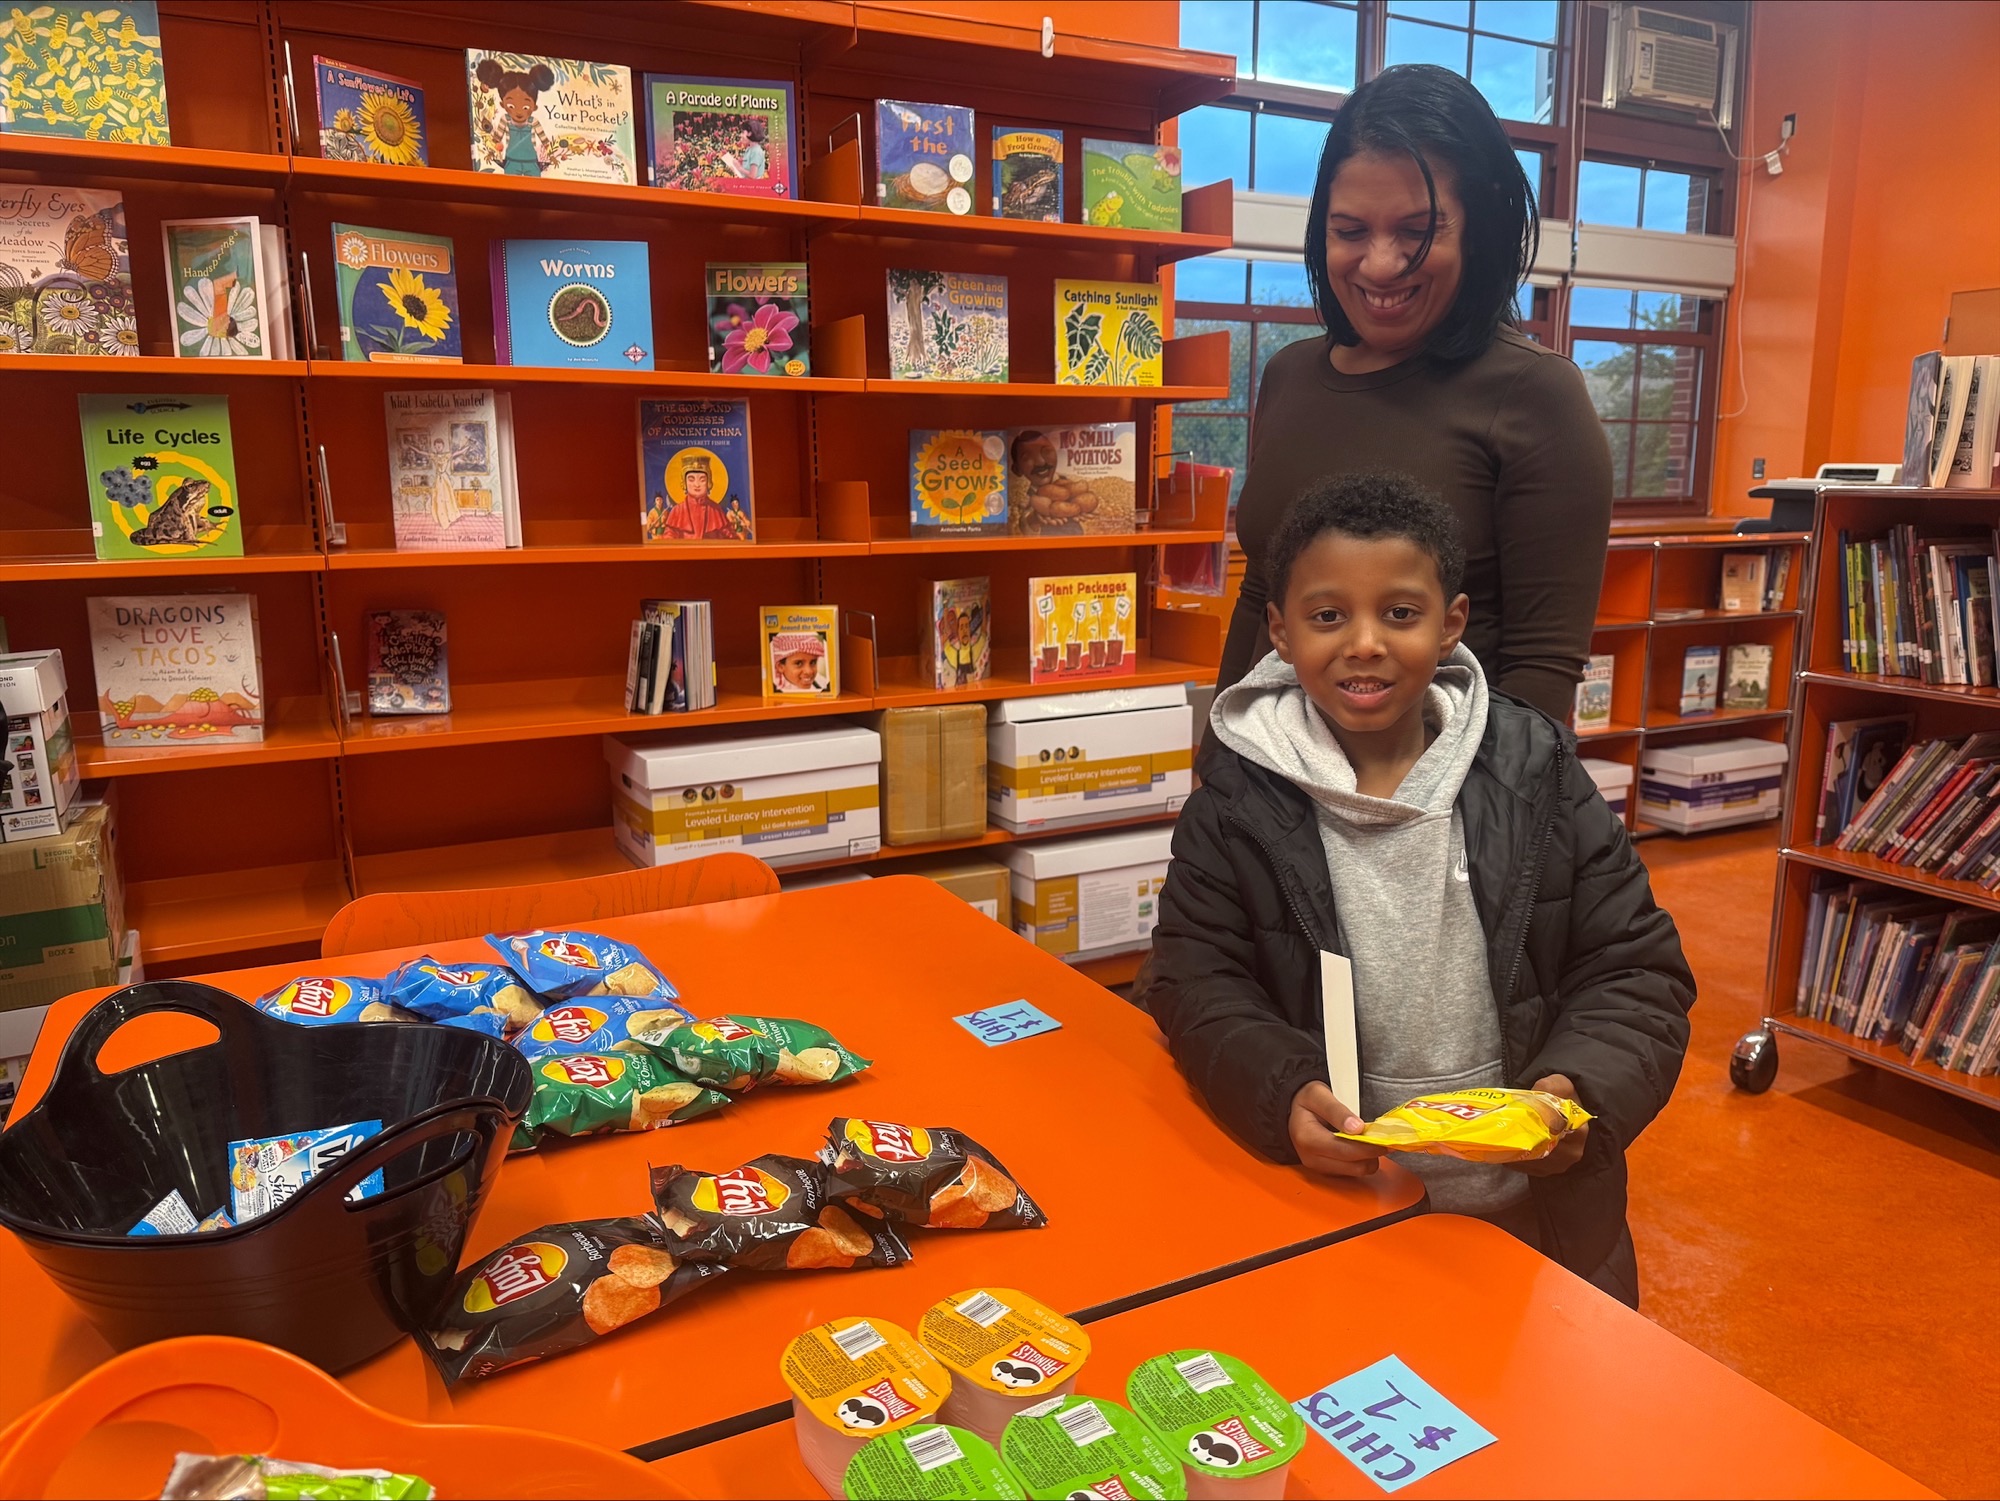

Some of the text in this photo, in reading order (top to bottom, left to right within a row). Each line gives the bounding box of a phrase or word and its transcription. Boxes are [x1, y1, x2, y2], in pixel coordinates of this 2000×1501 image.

[327, 70, 414, 102] A Sunflower's Life
[557, 90, 602, 109] What's
[666, 91, 778, 109] A Parade of Plants
[544, 105, 628, 126] Your Pocket?
[910, 136, 948, 155] the
[1015, 135, 1032, 143] How
[1092, 166, 1178, 214] The Trouble with Tadpoles
[48, 193, 85, 219] Eyes
[184, 229, 238, 277] Handsprings
[372, 243, 438, 267] Flowers
[540, 259, 615, 279] Worms
[715, 270, 798, 292] Flowers
[948, 277, 1003, 292] Green and
[949, 290, 1003, 308] Growing
[1065, 290, 1157, 306] Catching Sunlight
[390, 393, 484, 409] What Isabella Wanted
[655, 404, 731, 413] THE GODS AND
[664, 416, 724, 425] GODDESSES
[107, 429, 220, 447] Life Cycles
[648, 428, 742, 436] OF ANCIENT CHINA
[1060, 431, 1115, 448] NO SMALL
[955, 446, 964, 457] A
[1067, 449, 1121, 466] POTATOES
[937, 454, 982, 470] Seed
[922, 469, 998, 491] Grows
[1044, 582, 1127, 596] Plant Packages
[116, 605, 225, 625] DRAGONS
[141, 627, 204, 644] LOVE
[131, 646, 217, 666] TACOS
[1040, 765, 1142, 784] Leveled Literacy Intervention
[22, 818, 52, 826] LITERACY
[686, 804, 815, 827] Leveled Literacy Intervention
[784, 829, 811, 837] Materials
[33, 848, 46, 869] L
[44, 849, 72, 857] SECOND
[48, 949, 66, 957] BOX
[605, 941, 625, 970] Vinegar
[293, 978, 335, 1014] Lay's
[546, 1008, 591, 1040] Lay's
[768, 1021, 784, 1045] Onion
[964, 1011, 1017, 1042] CHIPS
[561, 1056, 609, 1082] Lay's
[794, 1168, 817, 1208] Barbecue
[570, 1230, 602, 1260] Barbecue
[881, 1245, 896, 1264] POTATO
[484, 1249, 546, 1304] Lay's
[1040, 1337, 1070, 1355] CHEDDAR
[1011, 1343, 1064, 1375] PRINGLES
[901, 1377, 925, 1398] CHEDDAR
[869, 1381, 919, 1419] PRINGLES
[1216, 1419, 1269, 1460] PRINGLES
[1248, 1414, 1285, 1447] SOUR CREAM
[1298, 1392, 1416, 1481] CHIPS
[1128, 1469, 1150, 1488] CREAM
